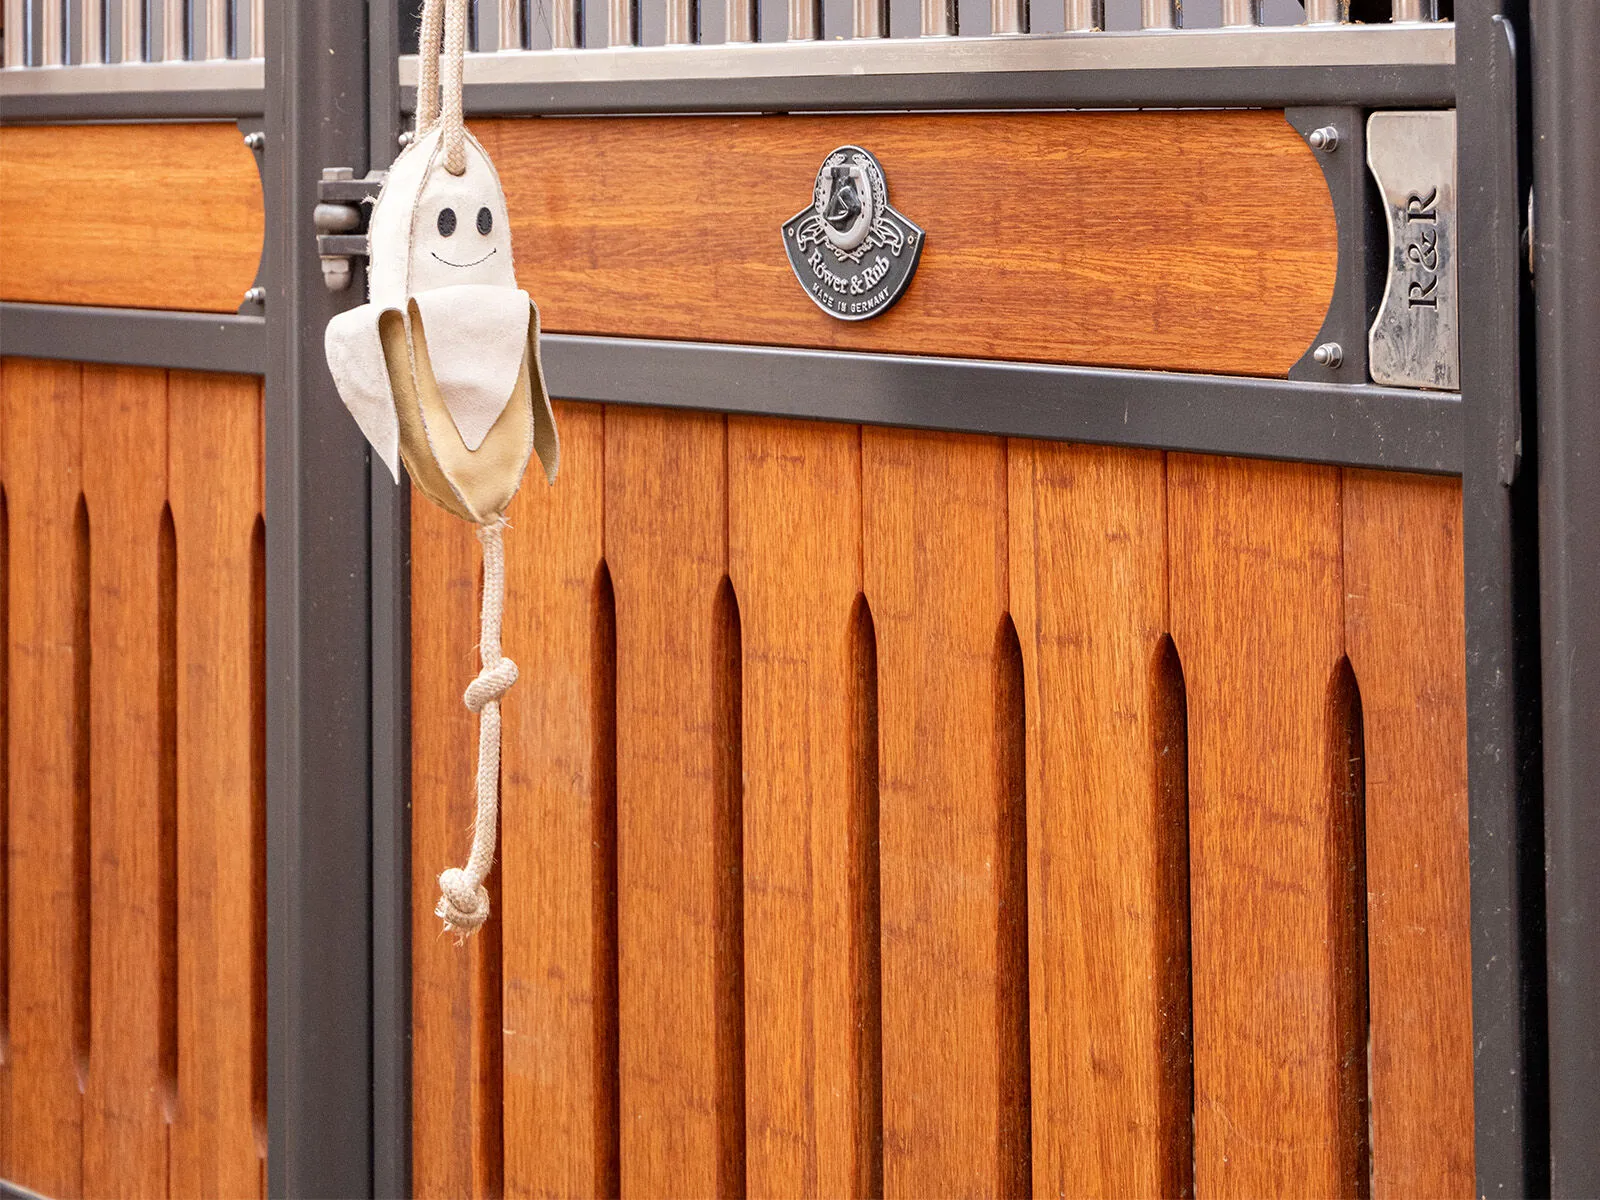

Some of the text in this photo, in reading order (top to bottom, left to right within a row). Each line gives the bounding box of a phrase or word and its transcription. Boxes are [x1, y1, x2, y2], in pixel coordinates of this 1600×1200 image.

[850, 275, 864, 295] &
[812, 283, 890, 313] MADE IN GERMANY
